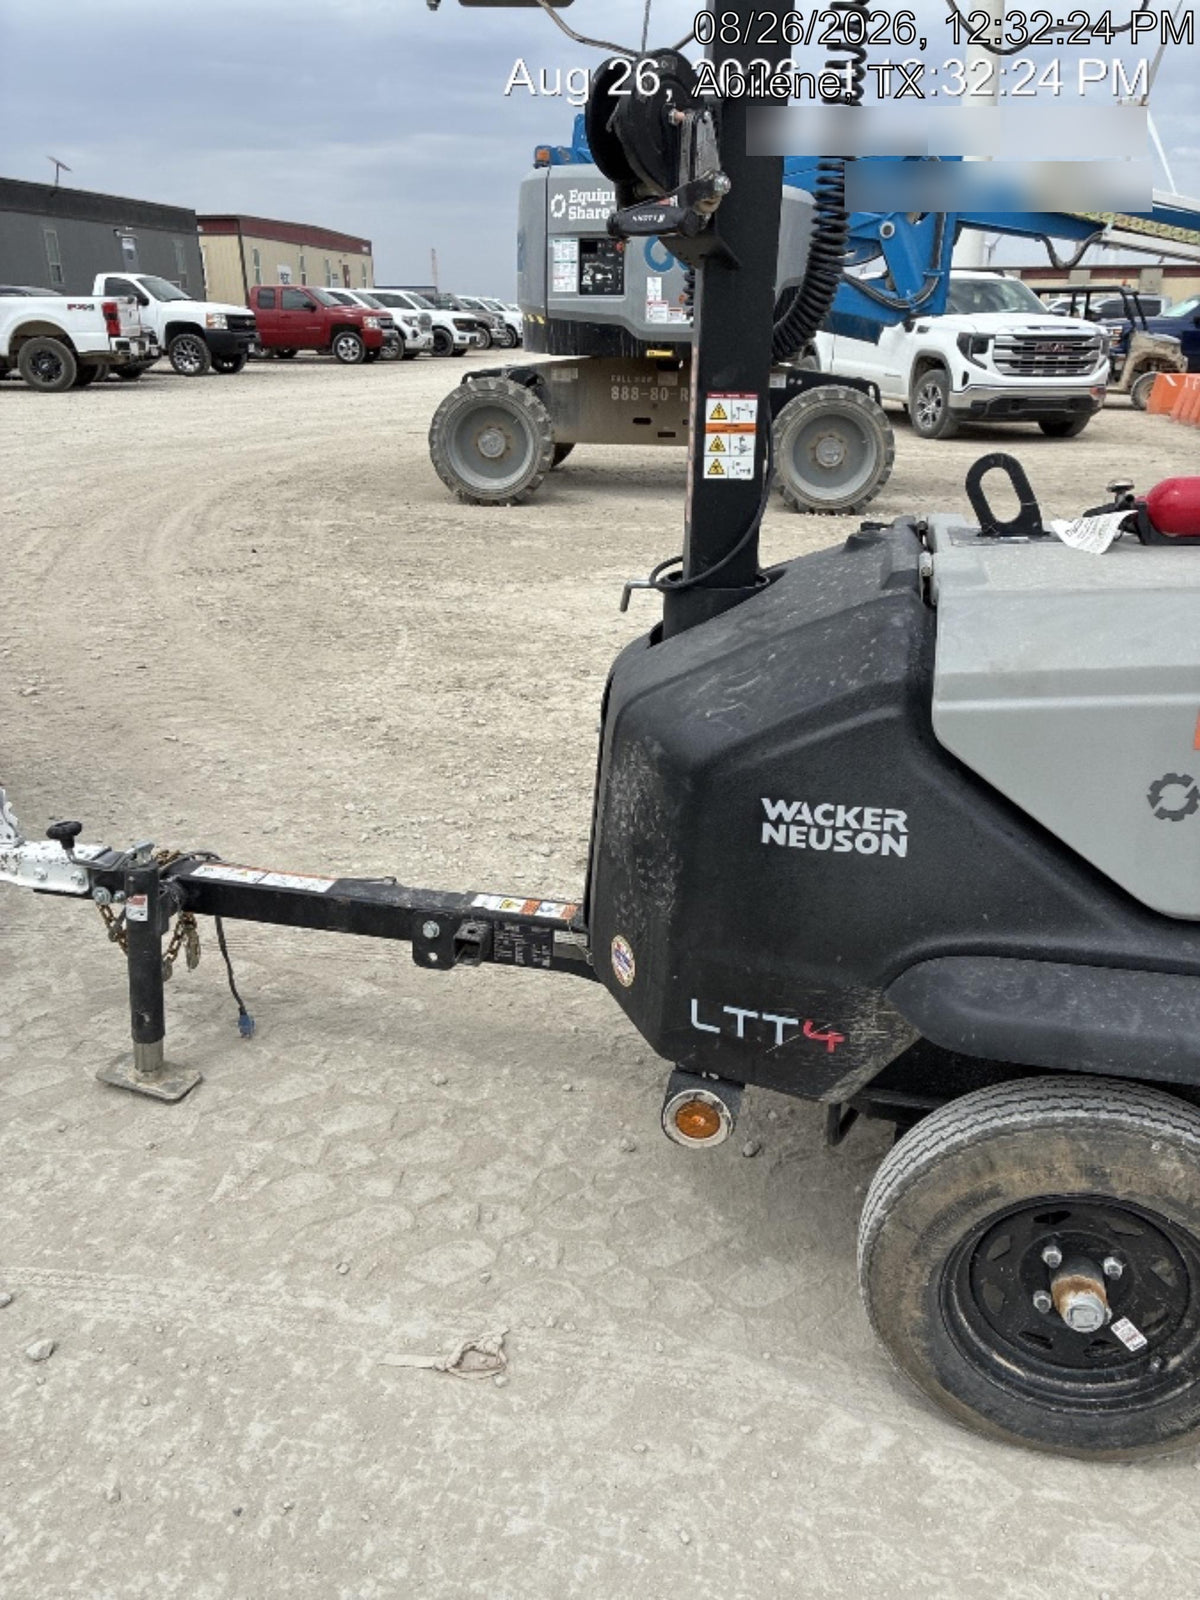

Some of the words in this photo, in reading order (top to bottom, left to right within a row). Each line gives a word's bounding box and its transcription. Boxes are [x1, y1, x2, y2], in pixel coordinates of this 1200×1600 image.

[568, 206, 611, 220] Share
[761, 797, 909, 833] WACKER
[760, 822, 908, 858] NEUSON
[690, 997, 846, 1054] LTT4
